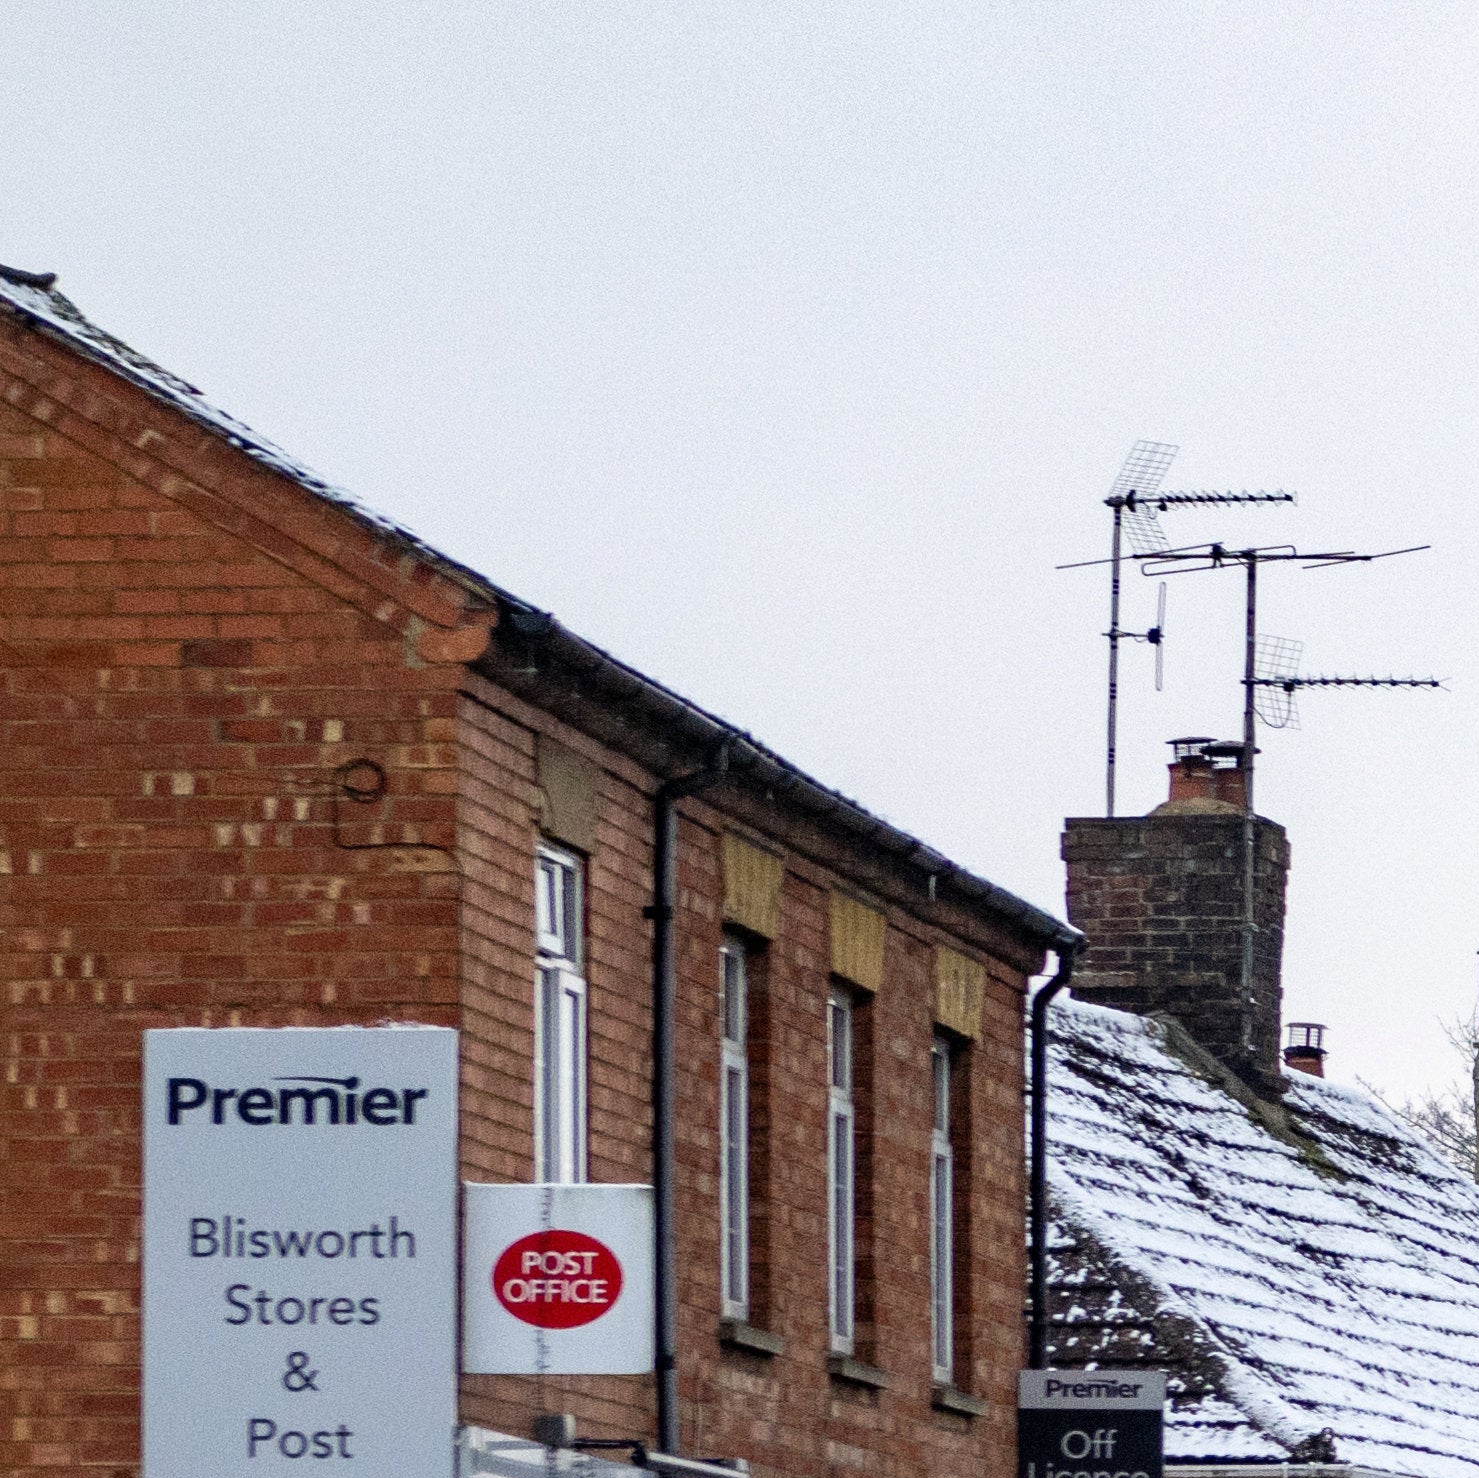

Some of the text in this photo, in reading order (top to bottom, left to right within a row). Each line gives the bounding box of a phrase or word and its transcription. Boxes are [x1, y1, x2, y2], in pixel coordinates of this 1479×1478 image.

[167, 1076, 429, 1126] Premier
[190, 1215, 416, 1258] Blisworth
[520, 1250, 599, 1275] POST
[225, 1284, 380, 1325] Stores
[502, 1279, 609, 1303] OFFICE
[282, 1351, 319, 1392] &
[1046, 1379, 1143, 1398] Premier
[247, 1418, 354, 1458] Post
[1061, 1429, 1118, 1459] Off
